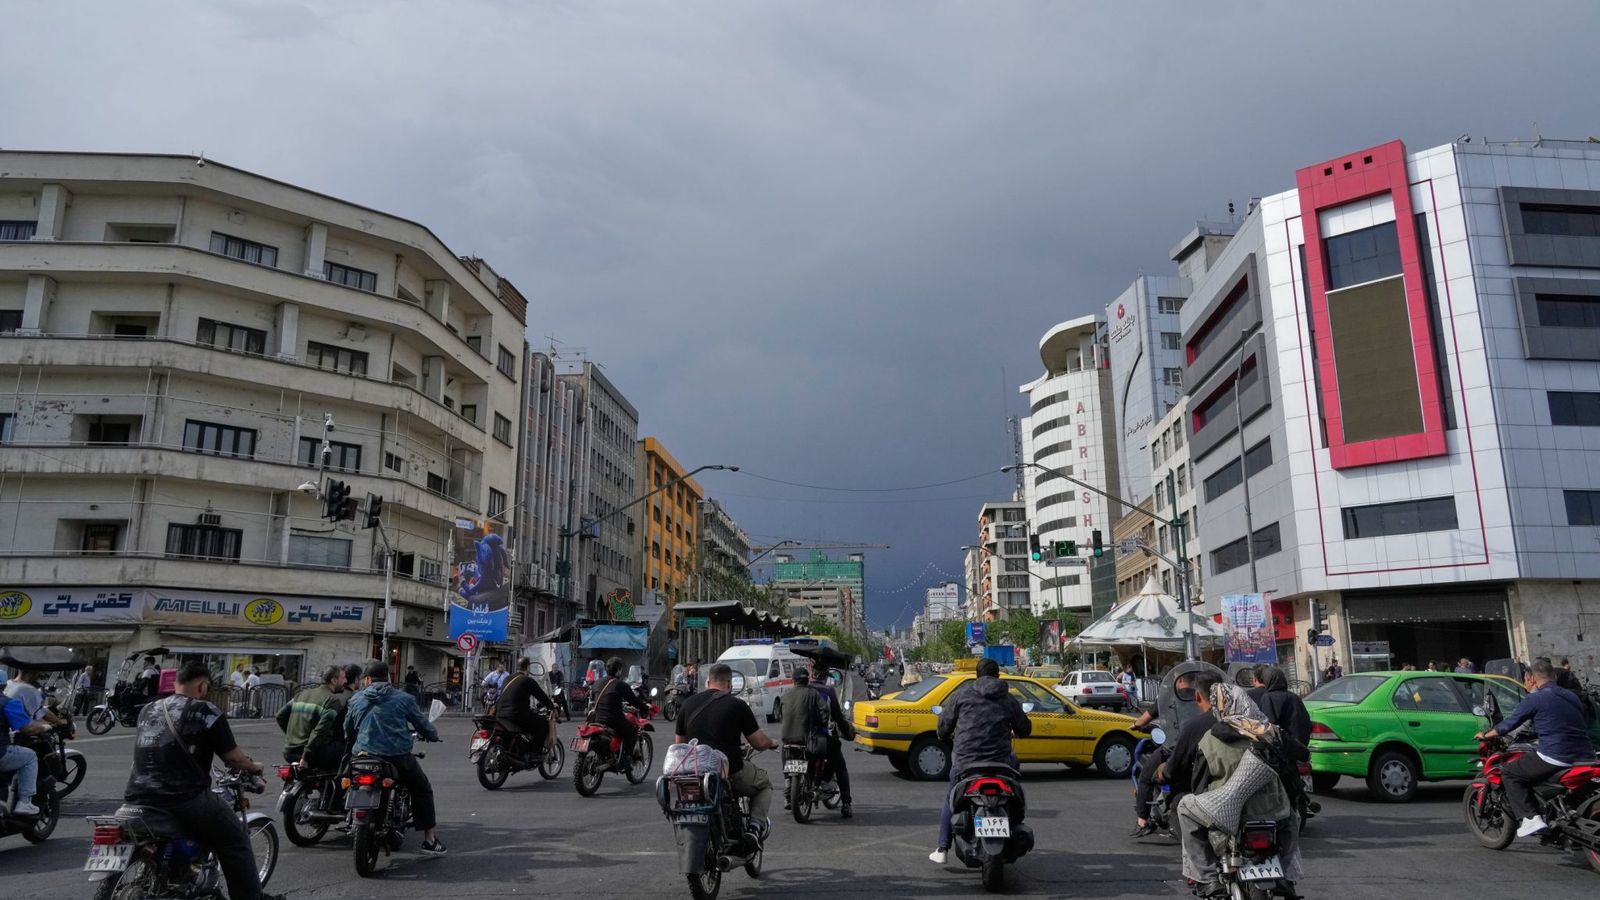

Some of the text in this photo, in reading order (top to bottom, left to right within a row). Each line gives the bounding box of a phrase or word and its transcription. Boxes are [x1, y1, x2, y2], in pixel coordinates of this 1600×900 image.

[80, 593, 133, 612] کفش
[153, 598, 240, 615] MELLI
[320, 605, 364, 622] کفش
